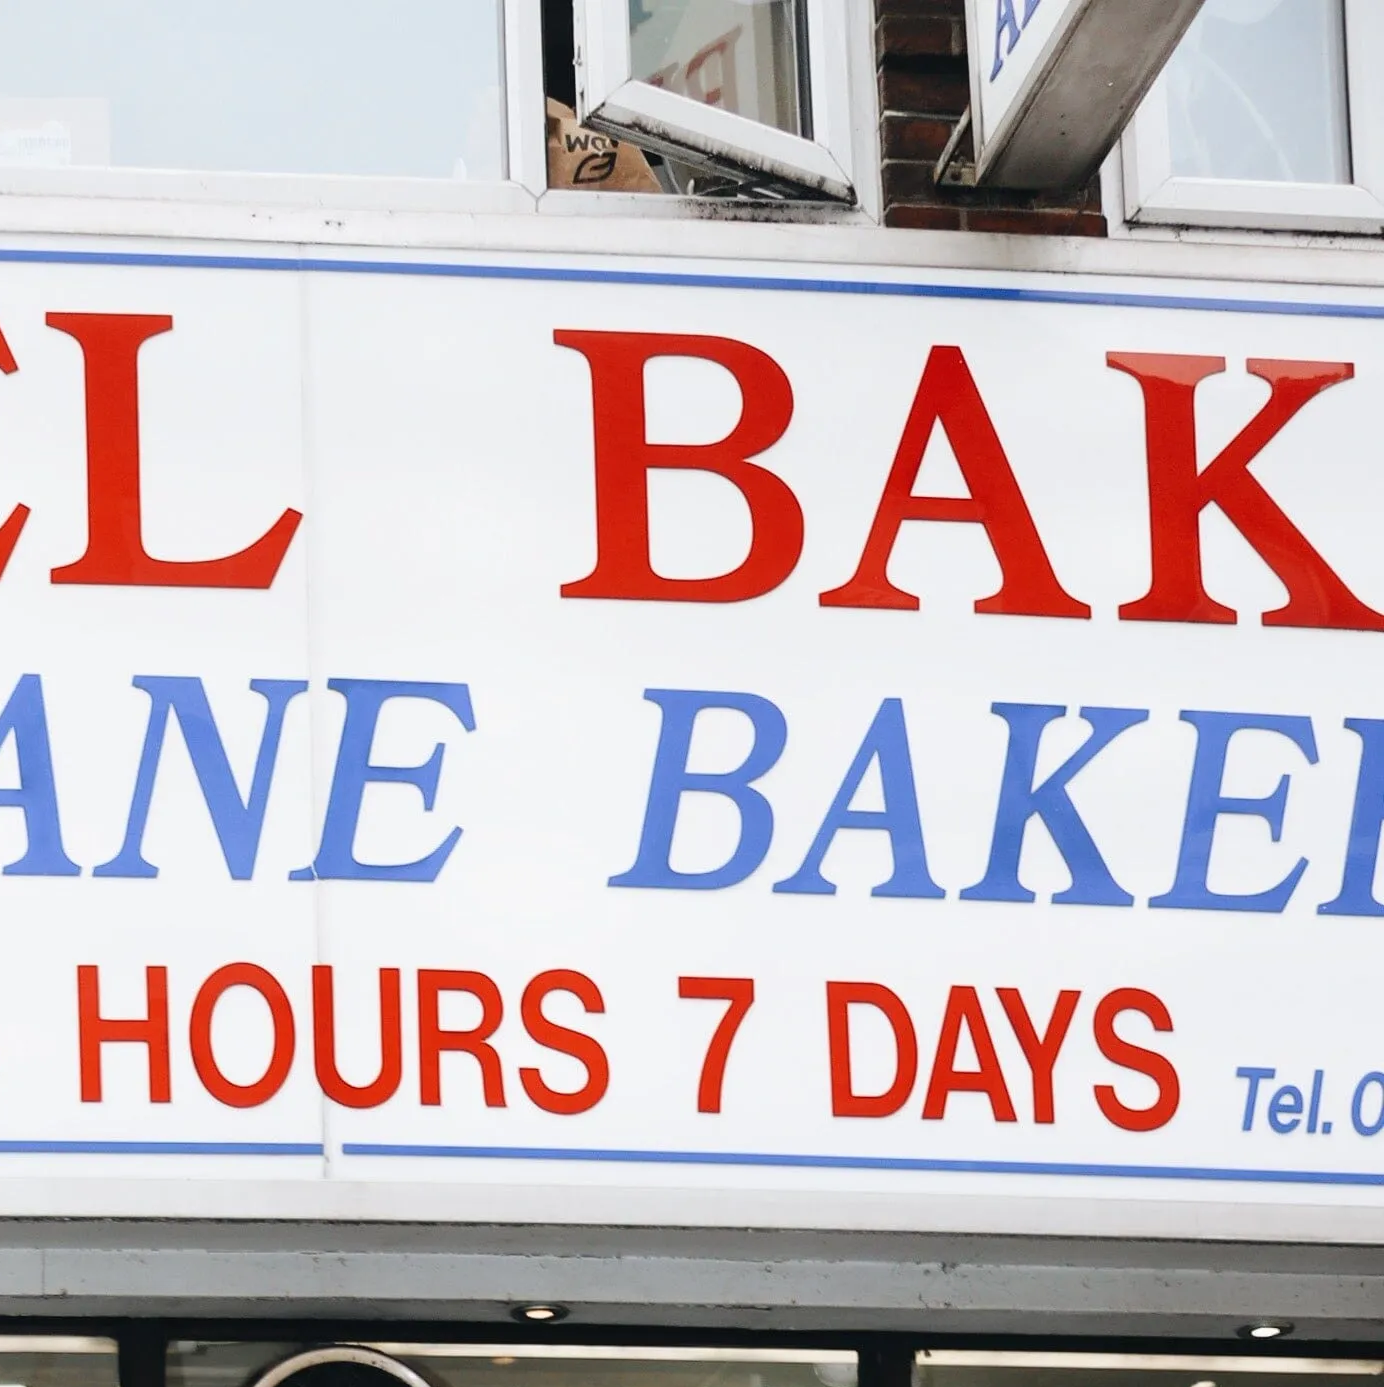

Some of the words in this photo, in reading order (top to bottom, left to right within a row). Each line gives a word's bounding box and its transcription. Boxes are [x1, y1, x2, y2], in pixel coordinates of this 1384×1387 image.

[607, 687, 1384, 918] BAKE
[76, 961, 611, 1116] HOURS
[677, 975, 756, 1114] 7
[825, 980, 1181, 1132] DAYS
